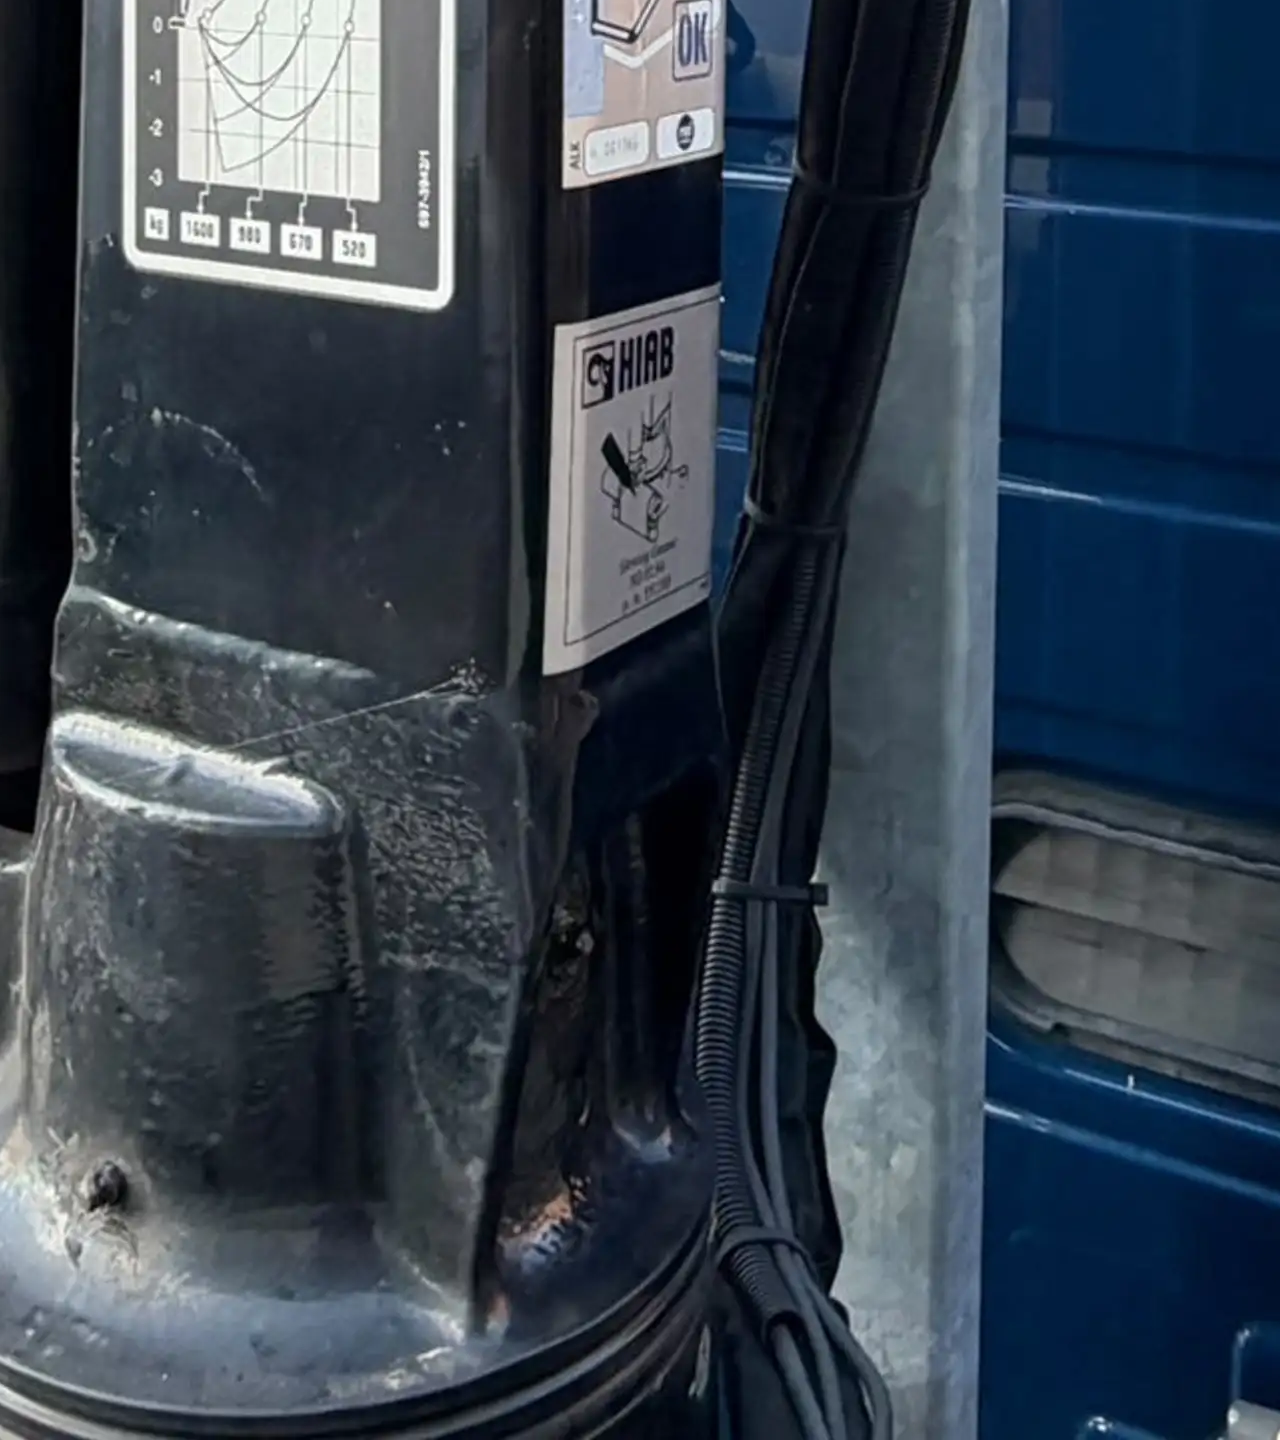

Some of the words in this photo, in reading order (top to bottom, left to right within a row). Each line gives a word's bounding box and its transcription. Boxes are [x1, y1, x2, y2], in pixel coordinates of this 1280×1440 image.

[152, 16, 163, 34] 0
[677, 10, 710, 70] OK
[148, 68, 162, 86] -1
[148, 118, 163, 138] -2
[148, 168, 163, 187] -3
[289, 233, 313, 252] 670
[342, 239, 366, 259] 520
[619, 326, 674, 394] HIAB
